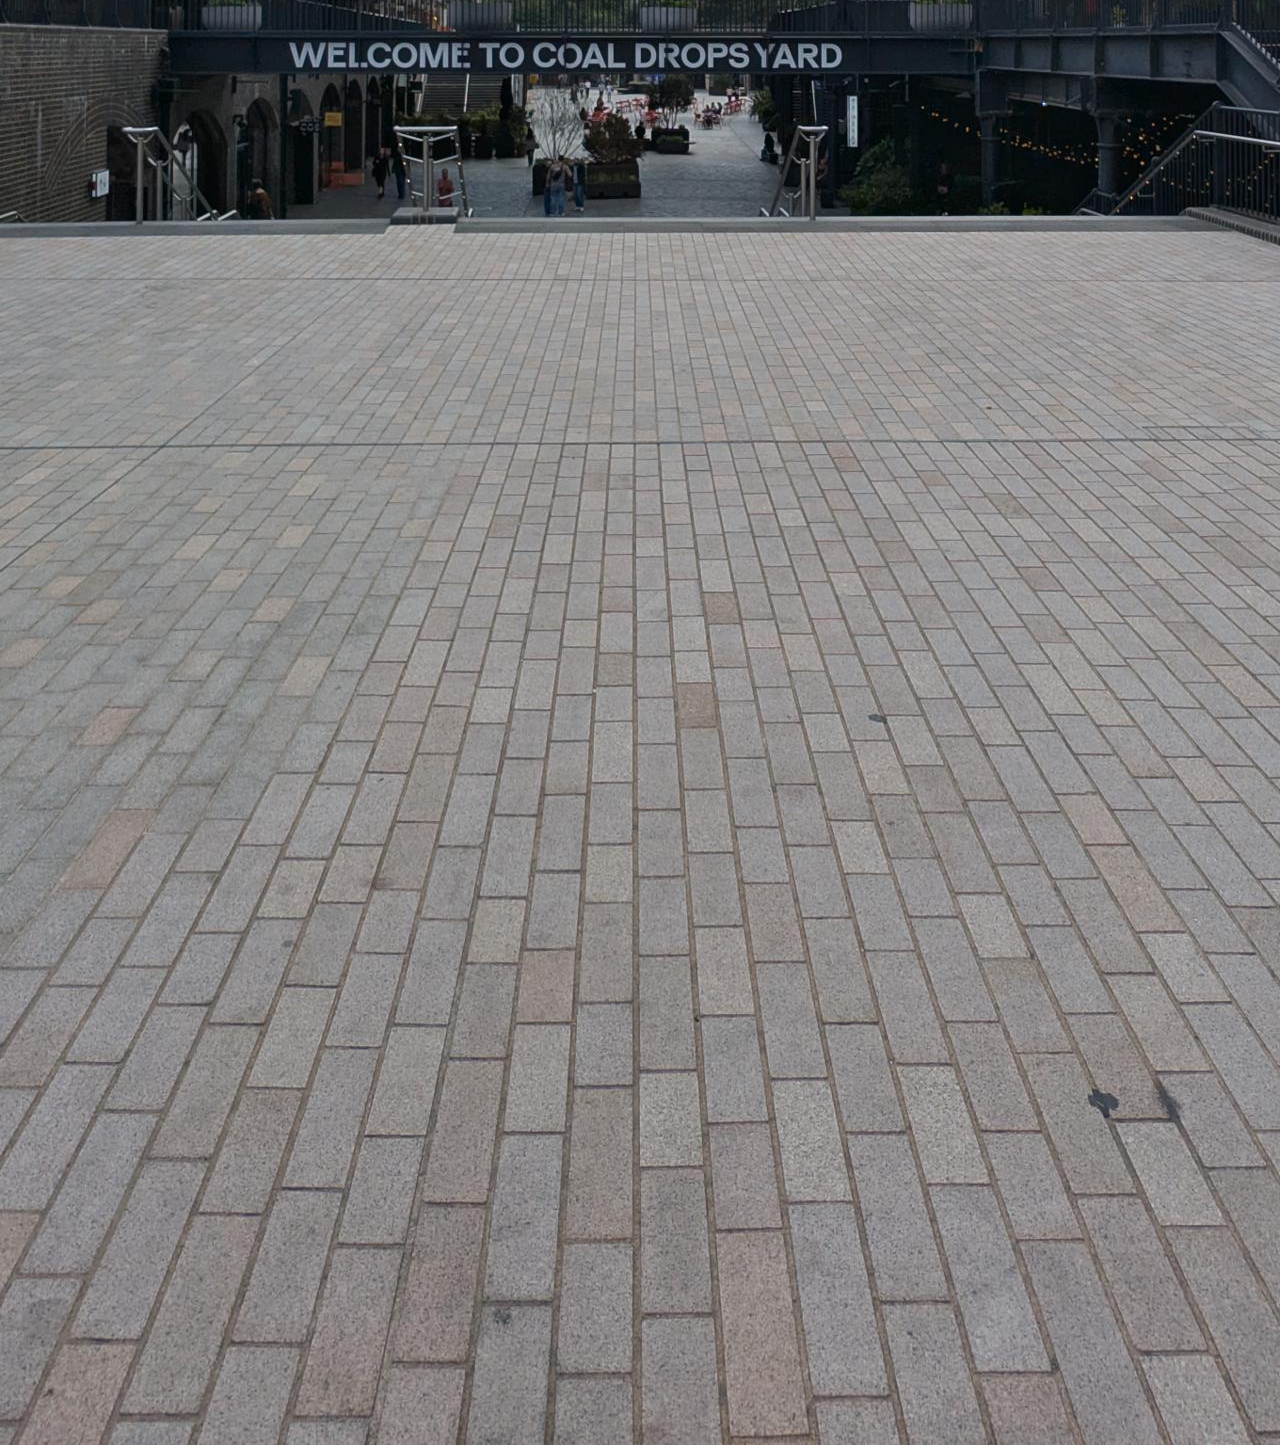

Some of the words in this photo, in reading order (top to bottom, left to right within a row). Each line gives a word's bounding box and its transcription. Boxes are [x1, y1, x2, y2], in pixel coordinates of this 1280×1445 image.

[289, 42, 470, 68] WELCOME
[479, 42, 524, 68] TO
[533, 42, 626, 68] COAL
[635, 42, 749, 68] DROPS
[754, 42, 842, 68] YARD
